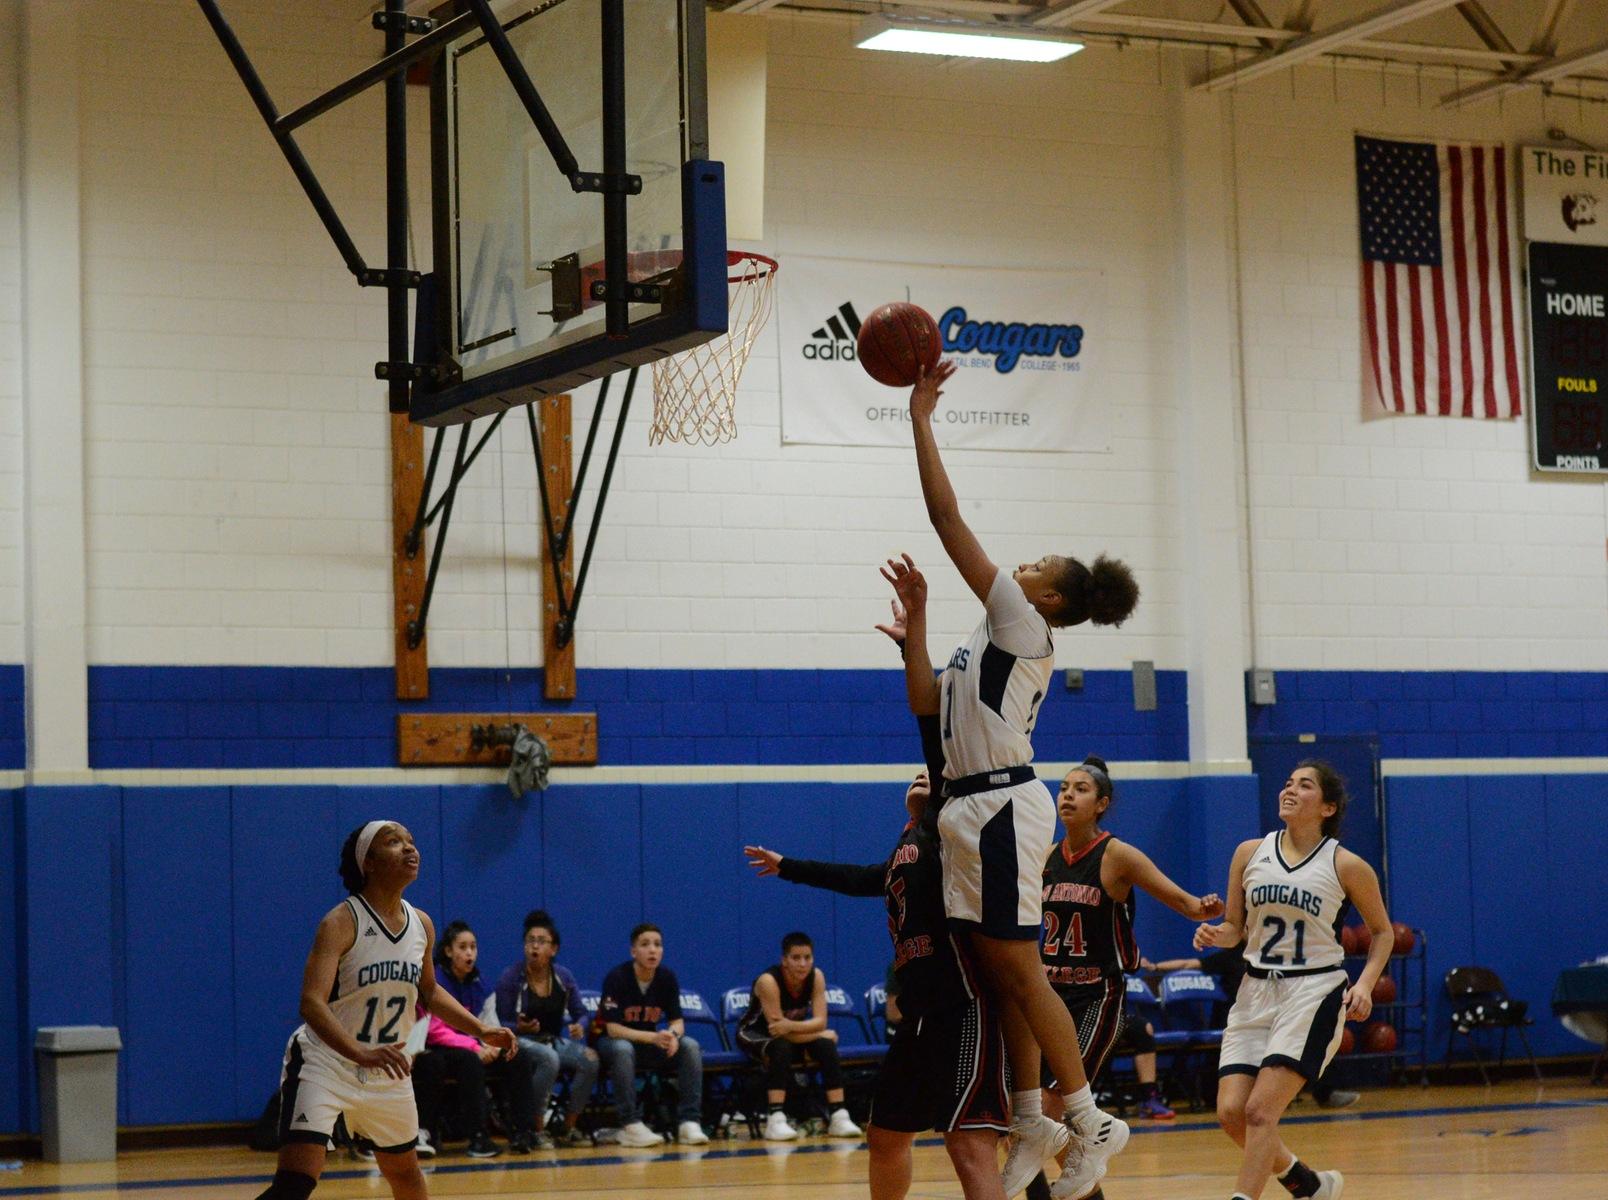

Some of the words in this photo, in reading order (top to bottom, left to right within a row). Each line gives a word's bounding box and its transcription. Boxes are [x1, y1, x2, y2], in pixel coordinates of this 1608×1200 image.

[1532, 151, 1576, 177] The
[1583, 157, 1608, 180] Fi
[1545, 291, 1606, 318] HOME
[802, 337, 857, 361] adid
[938, 306, 1083, 374] Cougars
[971, 357, 993, 369] BEND
[1020, 359, 1057, 372] COLLEGE
[1557, 376, 1598, 394] FOULS
[865, 406, 941, 424] OFFICL
[945, 409, 1031, 427] OUTFITTER
[1555, 454, 1601, 470] POINTS
[1251, 884, 1323, 917] COUGARS
[1043, 910, 1088, 957] 24
[1260, 915, 1307, 965] 21
[358, 960, 422, 987] COUGAR
[356, 996, 407, 1044] 12
